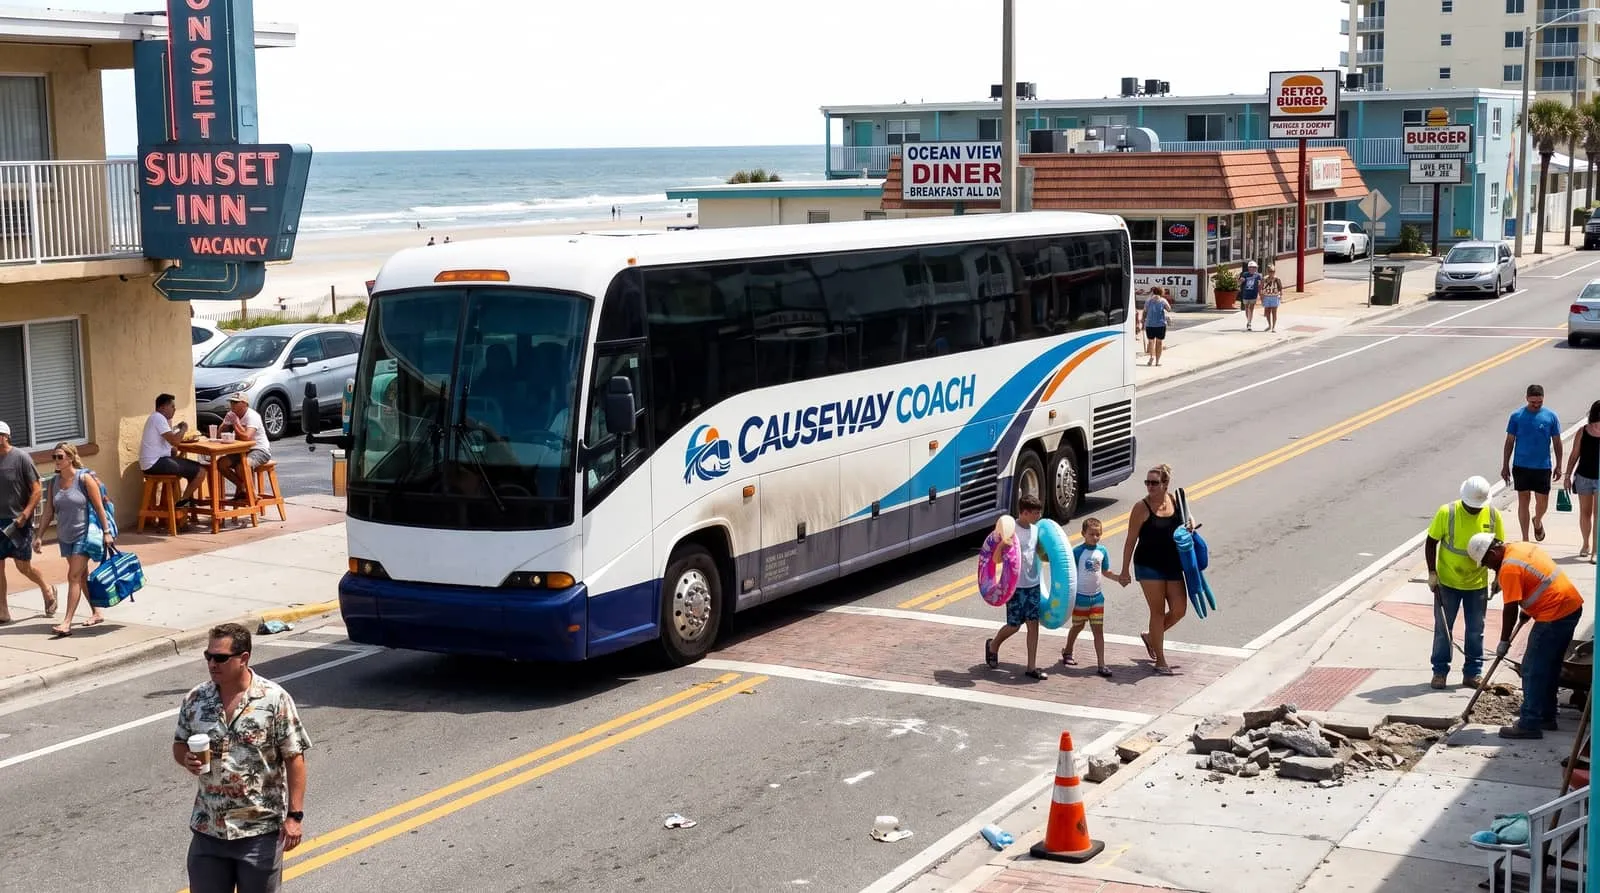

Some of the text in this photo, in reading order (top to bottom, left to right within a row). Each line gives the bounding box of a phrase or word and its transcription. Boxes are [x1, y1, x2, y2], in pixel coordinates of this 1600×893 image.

[1281, 87, 1324, 96] RETRO
[1277, 96, 1328, 106] BURGER
[1407, 131, 1467, 144] BURGER
[908, 146, 960, 160] OCEAN
[145, 152, 279, 186] SUNSET
[913, 163, 1002, 183] DINER
[966, 187, 984, 196] ALL
[986, 187, 1002, 196] DA
[176, 194, 246, 225] INN
[190, 237, 268, 256] VACANCY
[738, 374, 976, 463] CAUSEWAY COACH
